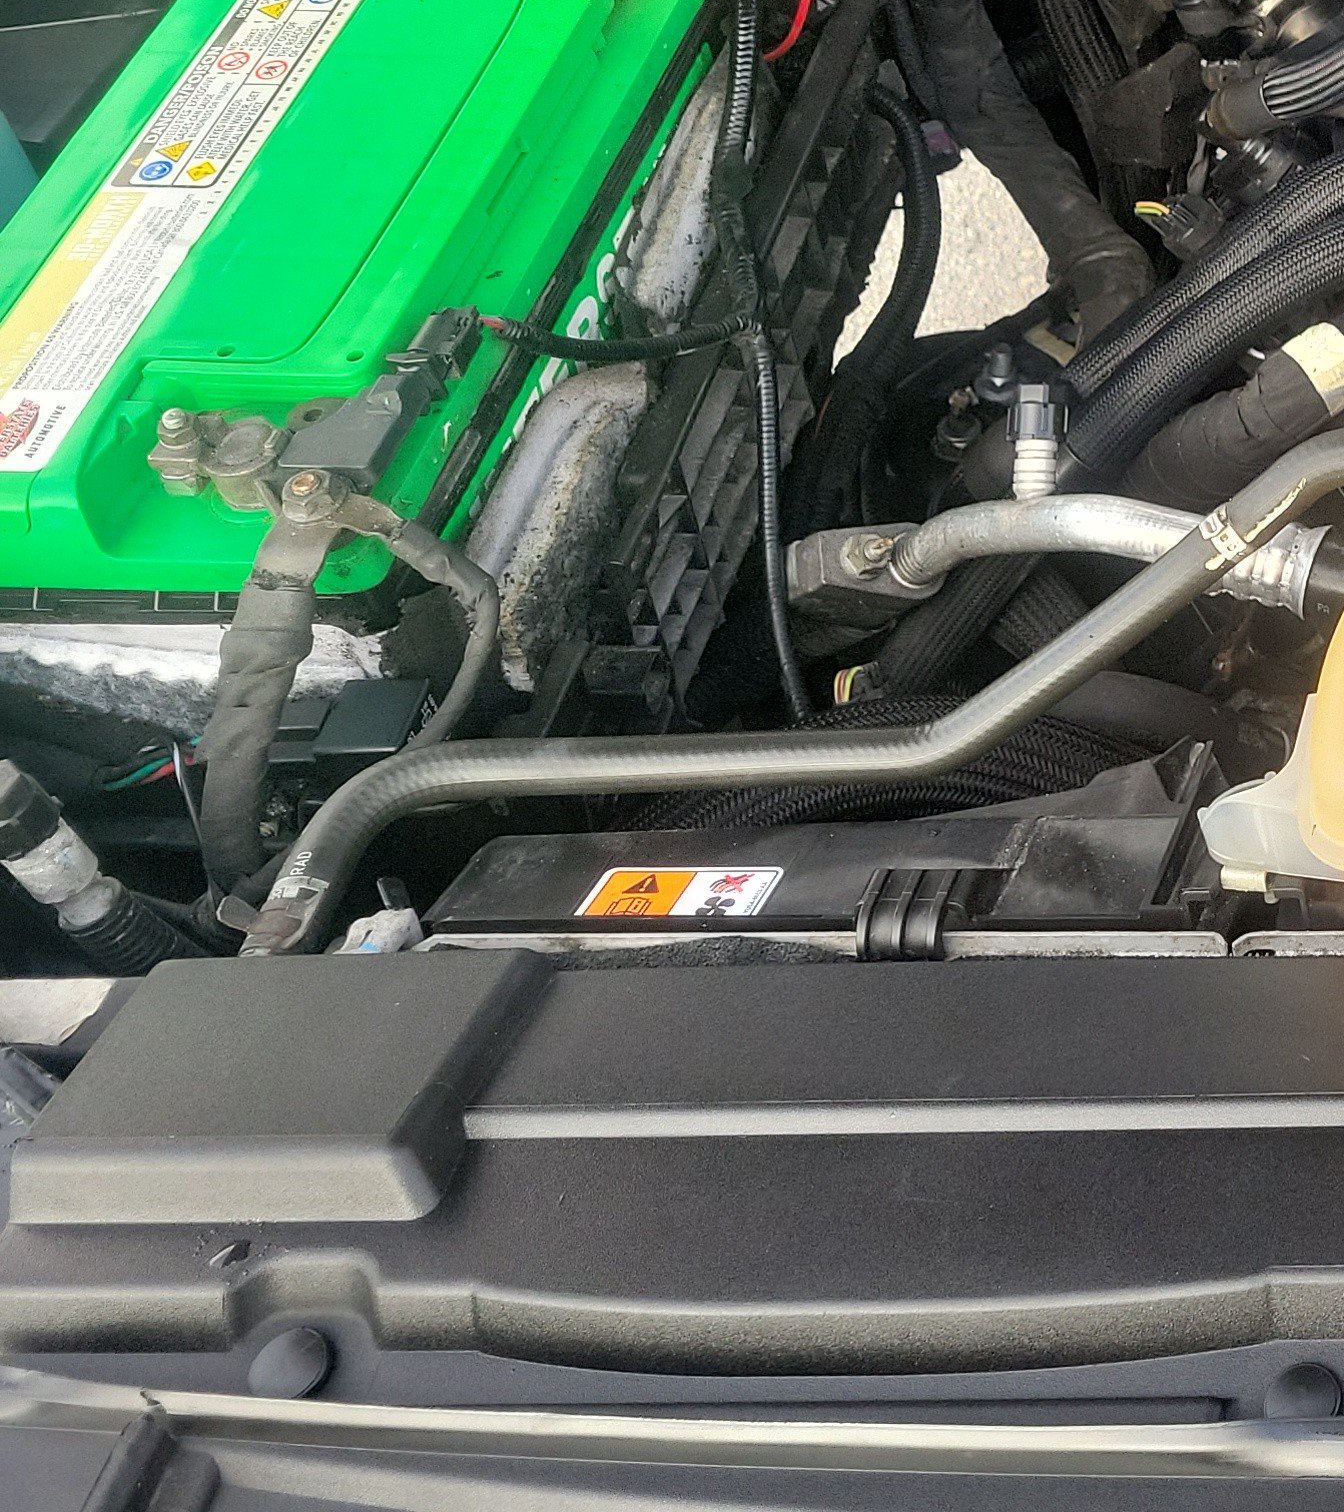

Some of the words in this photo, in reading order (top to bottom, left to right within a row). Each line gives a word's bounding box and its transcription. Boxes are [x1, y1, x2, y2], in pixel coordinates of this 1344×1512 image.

[143, 46, 223, 143] DANGER/POISON
[216, 132, 244, 159] MEDICAL
[12, 344, 54, 389] PROPOSITION
[24, 405, 66, 458] AUTOMOTIVE
[290, 852, 312, 875] RAD
